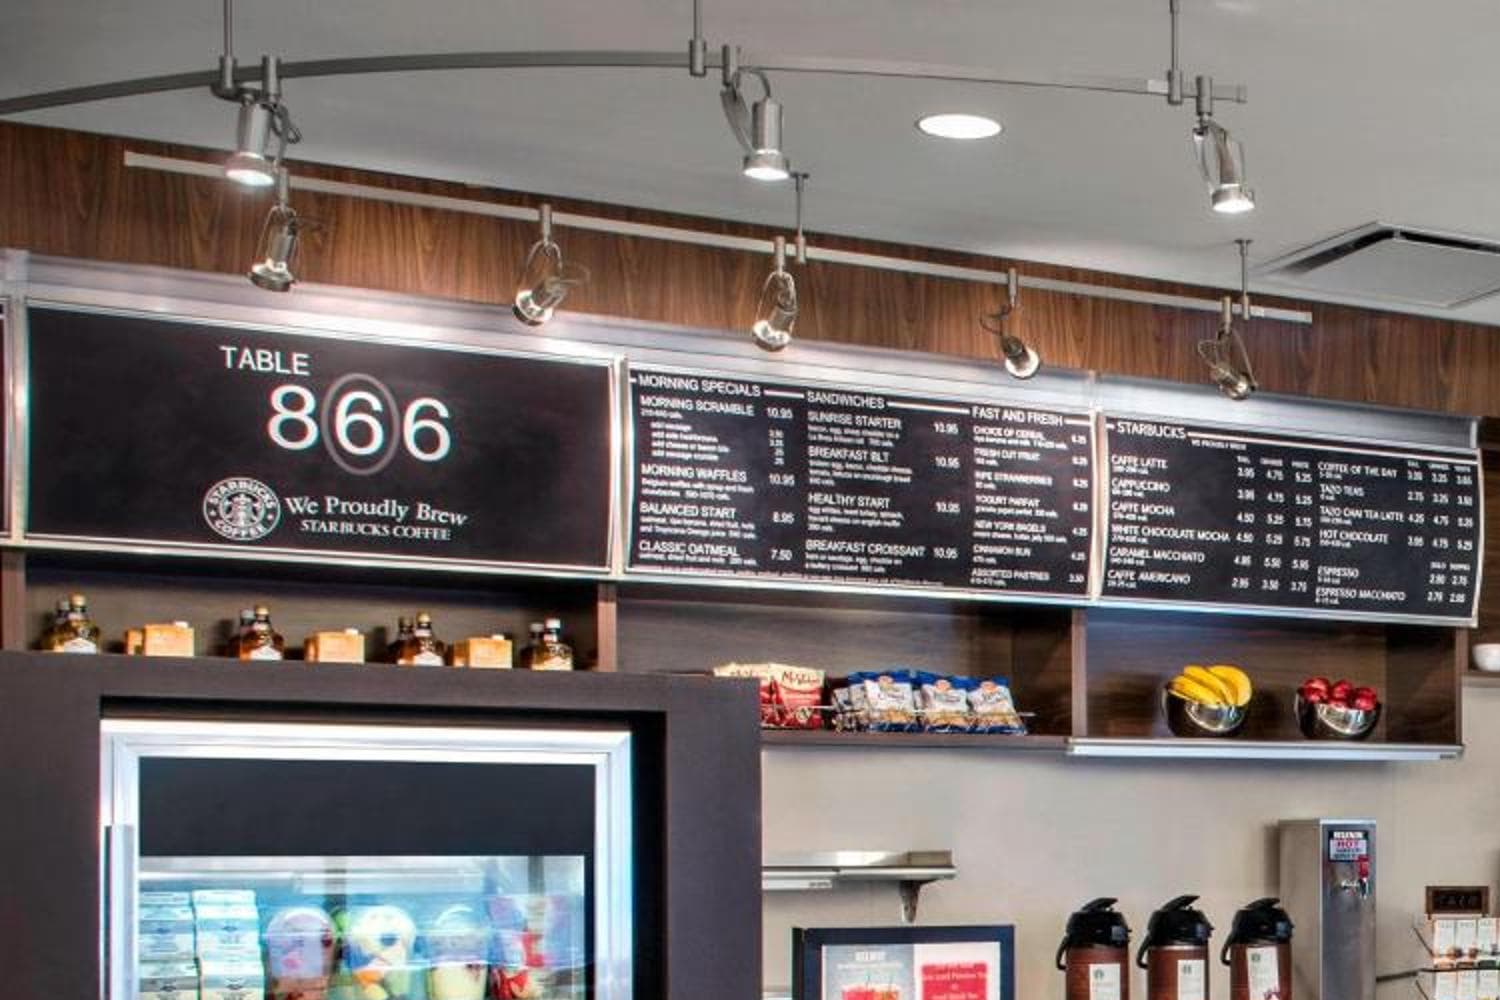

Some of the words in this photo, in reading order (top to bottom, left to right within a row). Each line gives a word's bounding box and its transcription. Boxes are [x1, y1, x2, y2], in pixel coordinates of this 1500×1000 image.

[219, 345, 311, 376] TABLE
[638, 374, 699, 392] MORNING
[701, 379, 761, 397] SPECIALS
[640, 395, 693, 411] MORNING
[695, 400, 755, 417] SCRAMBLE
[766, 407, 794, 419] 10.95
[807, 391, 885, 409] SANDWICHES
[267, 384, 452, 462] 866
[807, 410, 853, 425] SUNRISE
[855, 415, 902, 430] STARTER
[972, 405, 1000, 419] FAST
[1002, 409, 1025, 422] AND
[1027, 411, 1063, 426] FRESH
[1117, 422, 1187, 439] STARBUCKS
[808, 445, 867, 461] BREAKFAST
[870, 450, 889, 463] BLT
[935, 456, 960, 469] 10.95
[1111, 454, 1138, 466] CAFFE
[1139, 456, 1168, 469] LATTE
[641, 463, 694, 479] MORNING
[695, 466, 748, 482] WAFFLES
[768, 473, 795, 486] 10.95
[1317, 461, 1348, 474] COFFEE
[1351, 465, 1363, 475] OF
[1364, 466, 1380, 477] THE
[1381, 468, 1397, 479] DAY
[1111, 478, 1170, 492] CAPPUCCINO
[1319, 483, 1342, 495] TAZO
[209, 480, 278, 510] STARBUCKS
[808, 492, 856, 506] HEALTHY
[858, 495, 890, 509] START
[975, 495, 1007, 505] YOGURT
[285, 496, 319, 515] We
[326, 496, 409, 523] Proudly
[416, 502, 468, 527] Brew
[639, 502, 699, 517] BALANCED
[701, 505, 736, 519] START
[1111, 502, 1138, 513] CAFFE
[1141, 504, 1175, 516] MOCHA
[1319, 505, 1342, 517] TAZO
[1343, 507, 1363, 518] CHAI
[1364, 509, 1380, 520] TEA
[1380, 510, 1405, 523] LATTE
[214, 518, 269, 537] COFFEE
[300, 519, 390, 538] STARBUCKS
[392, 524, 452, 541] COFFEE
[975, 519, 993, 529] NEW
[1015, 522, 1047, 533] BAGELS
[1111, 524, 1139, 536] WHITE
[1141, 526, 1195, 541] CHOCOLATE
[1197, 530, 1230, 542] MOCHA
[1319, 529, 1338, 540] HOT
[1339, 530, 1390, 544] CHOCOLATE
[639, 540, 686, 554] CLASSIC
[688, 543, 739, 557] OATMEAL
[805, 538, 866, 553] BREAKFAST
[867, 543, 925, 557] CROISSANT
[1015, 547, 1032, 557] BUN
[1110, 547, 1152, 559] CARAMEL
[1153, 550, 1205, 563] MACCHIATO
[1107, 569, 1136, 580] CAFFE
[1137, 571, 1191, 585] AMERICANO
[1317, 565, 1360, 578] ESPRESSO
[1315, 586, 1357, 599] ESPRESSO
[1358, 588, 1407, 602] MACCHIATO
